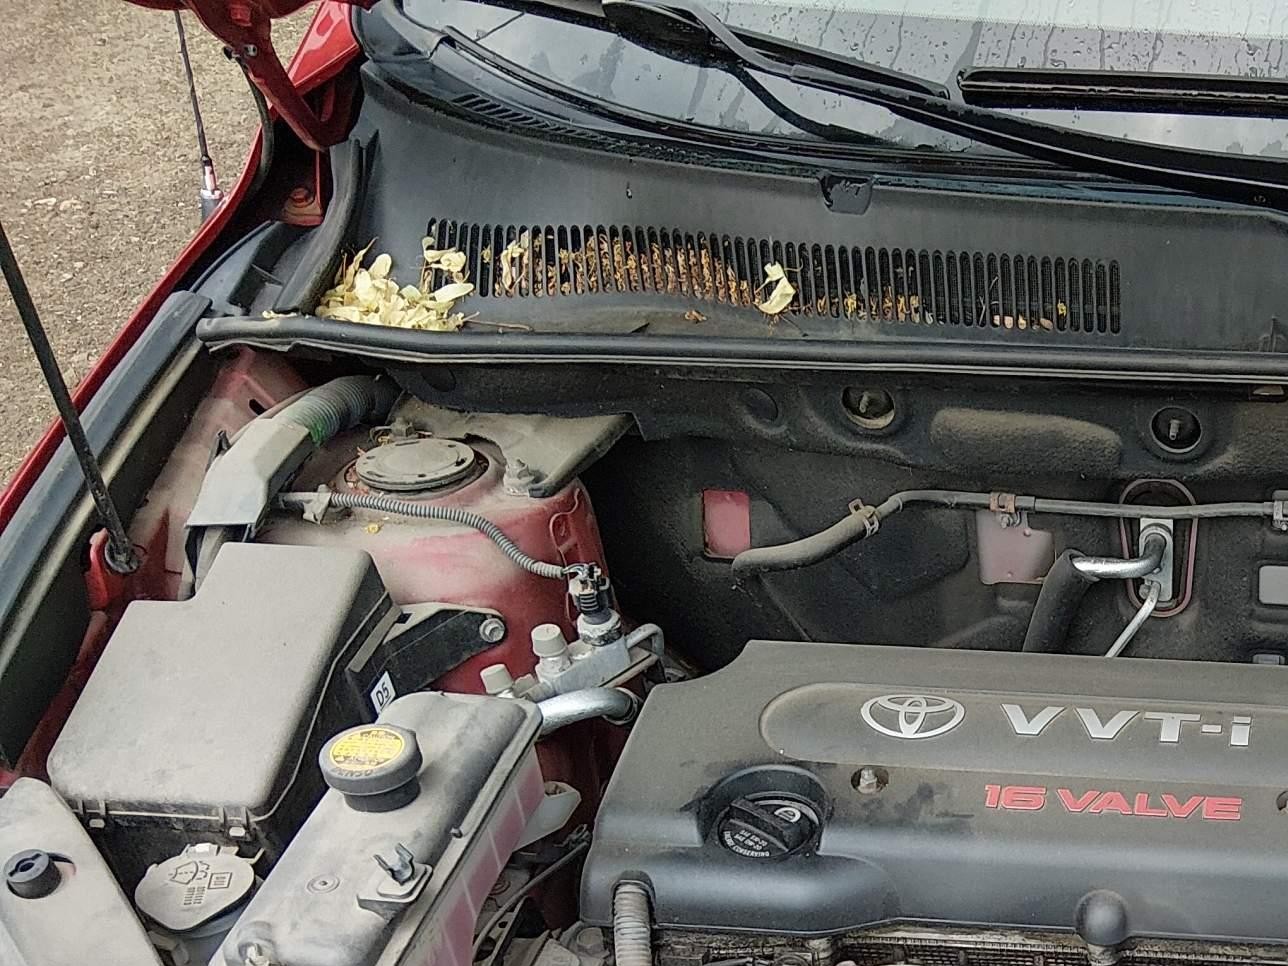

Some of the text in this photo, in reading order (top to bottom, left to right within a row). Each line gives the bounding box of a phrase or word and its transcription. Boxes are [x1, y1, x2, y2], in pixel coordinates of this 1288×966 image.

[376, 682, 390, 707] D5
[1000, 703, 1252, 747] VVT-i
[984, 784, 1244, 820] 16 VALVE
